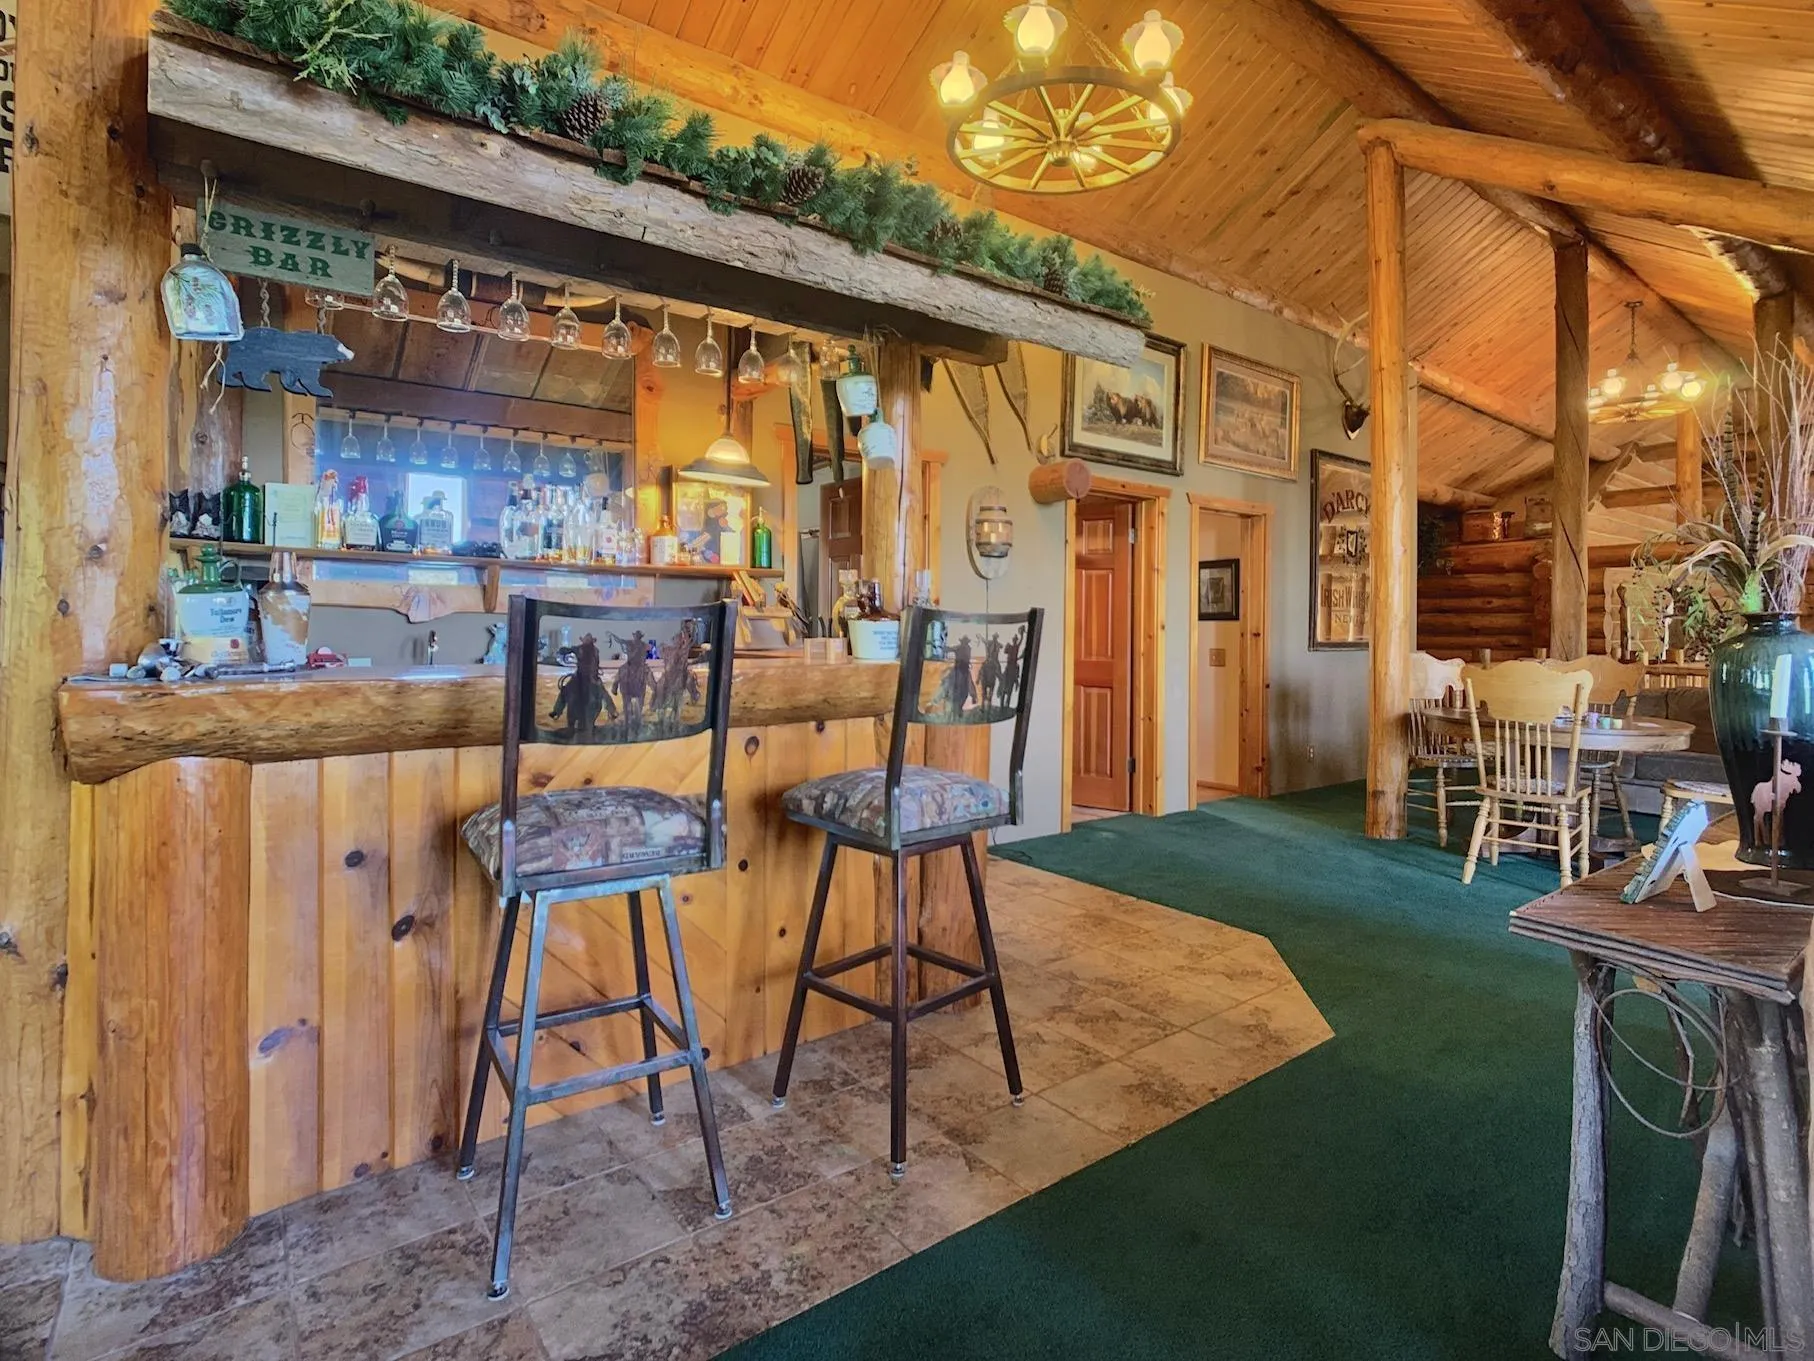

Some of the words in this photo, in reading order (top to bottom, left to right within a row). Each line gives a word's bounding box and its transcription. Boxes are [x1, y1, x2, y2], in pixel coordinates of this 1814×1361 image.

[202, 211, 371, 259] GRIZZLY
[246, 245, 333, 278] BAR
[1321, 583, 1344, 609] IRISH
